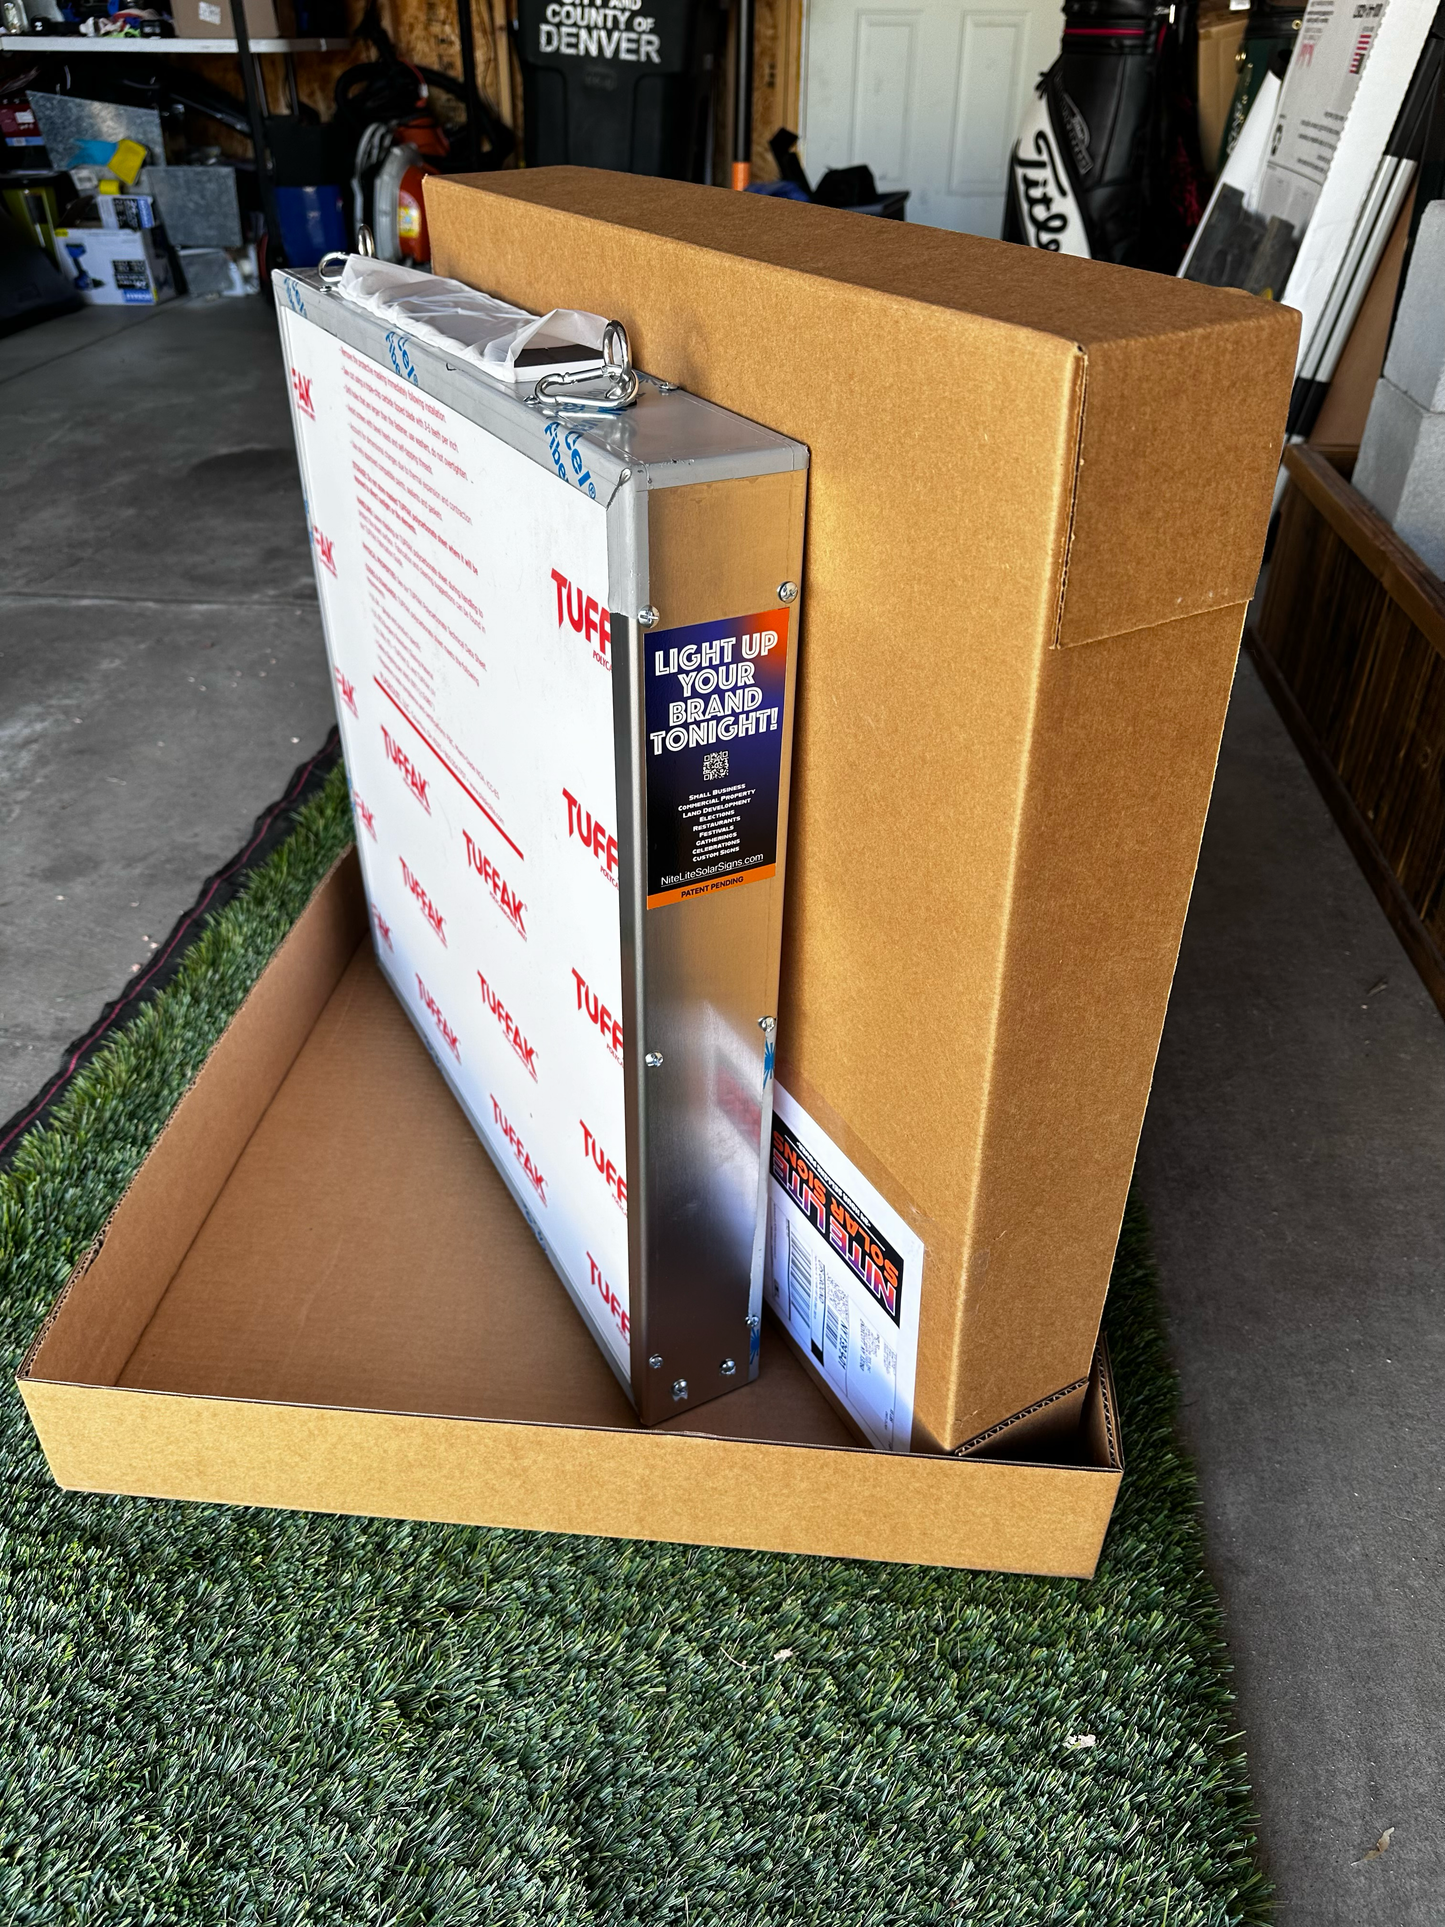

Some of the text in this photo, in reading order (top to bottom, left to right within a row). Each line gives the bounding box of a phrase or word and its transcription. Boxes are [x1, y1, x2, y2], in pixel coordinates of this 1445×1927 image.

[539, 23, 661, 64] DENVER
[546, 3, 655, 32] COUNTY OF
[1012, 130, 1068, 251] Title
[551, 568, 611, 655] TUFF
[655, 630, 778, 676] LIGHT UP
[669, 687, 762, 727] BRAND
[678, 661, 755, 697] YOUR
[381, 724, 430, 809] TUFFAK
[650, 707, 778, 755] TONIGHT!
[562, 787, 618, 873] TUFF
[660, 853, 764, 886] NiteLiteSolarSigns.com
[399, 855, 446, 942] TUFFAK
[462, 828, 526, 934] TUFFAK
[681, 875, 744, 898] PATENT PENDING
[415, 972, 460, 1061] TUFFAK
[477, 969, 537, 1077] TUFFAK
[571, 967, 623, 1052] TUFF
[490, 1093, 545, 1201] TUFFAK
[579, 1119, 627, 1203] TUFF
[772, 1148, 896, 1316] NITE LITE
[773, 1130, 899, 1288] SOLAR SIGNS
[586, 1251, 630, 1333] TUFF
